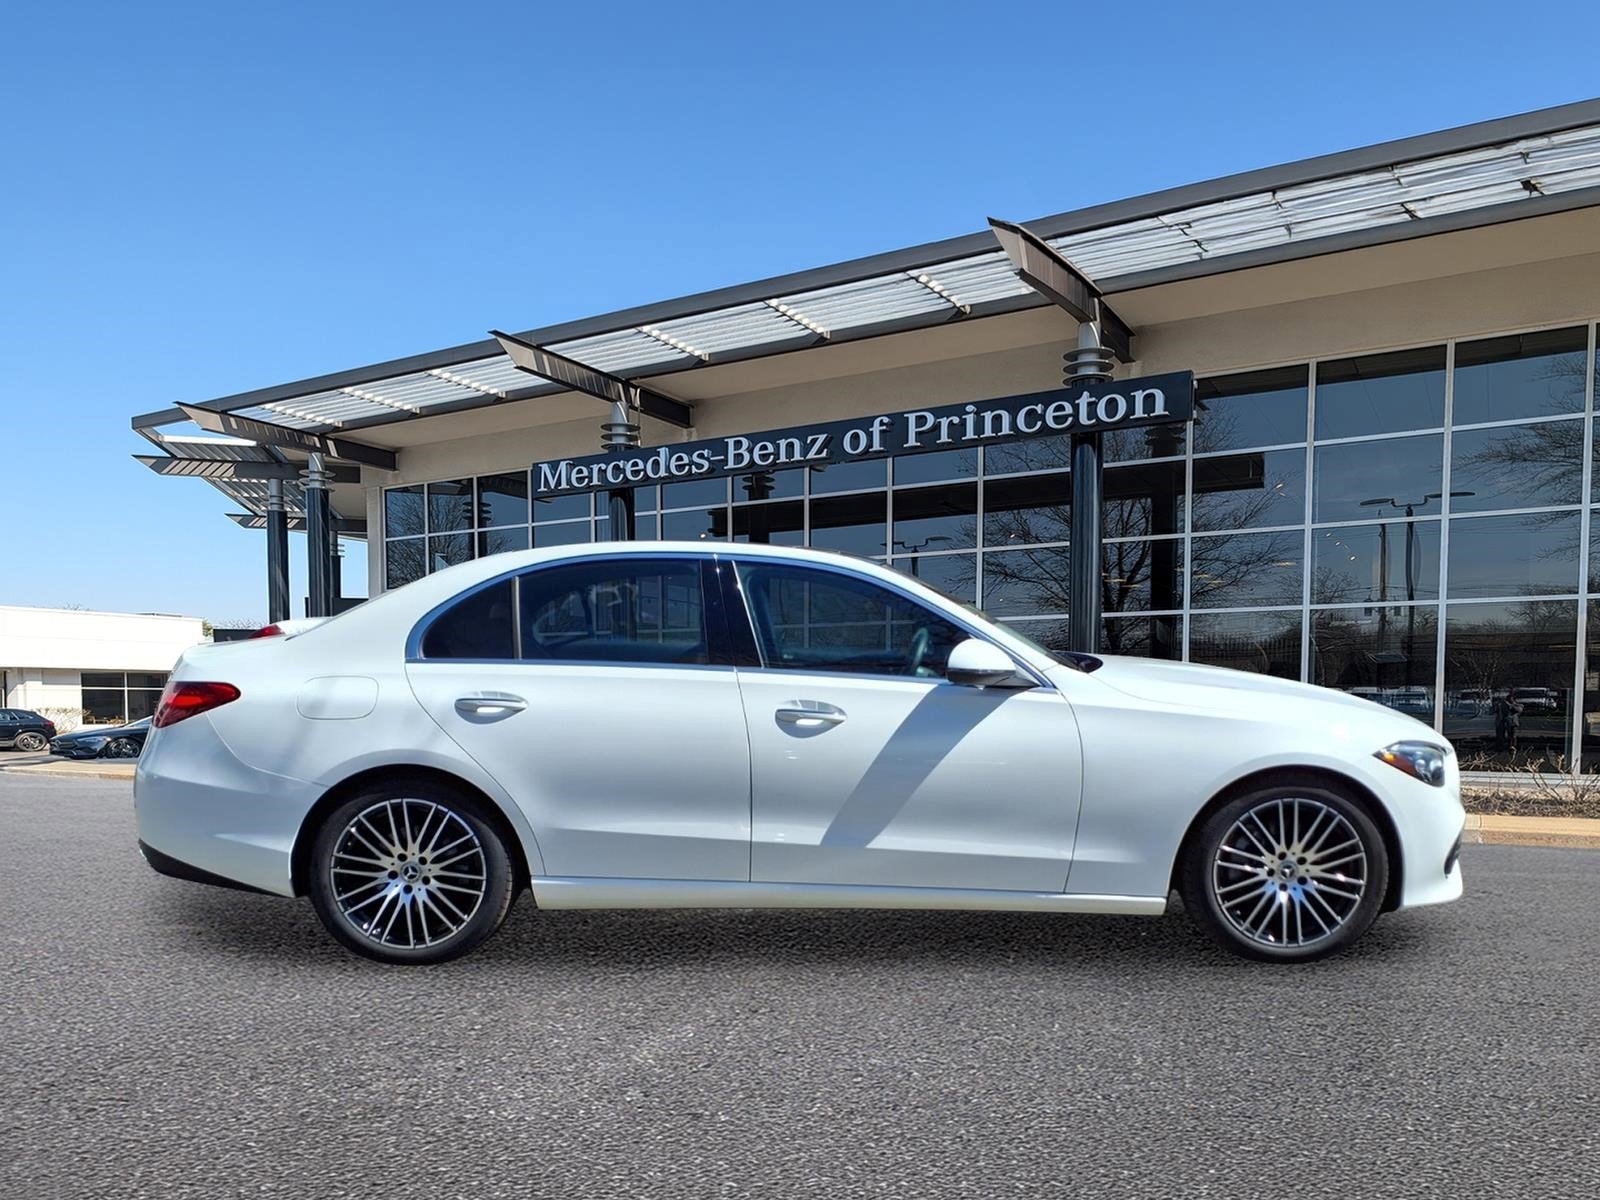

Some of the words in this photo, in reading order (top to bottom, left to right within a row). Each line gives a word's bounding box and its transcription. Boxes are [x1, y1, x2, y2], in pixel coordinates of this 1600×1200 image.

[537, 433, 829, 492] Mercedes-Benz
[842, 416, 891, 454] of
[903, 386, 1167, 447] Princeton
